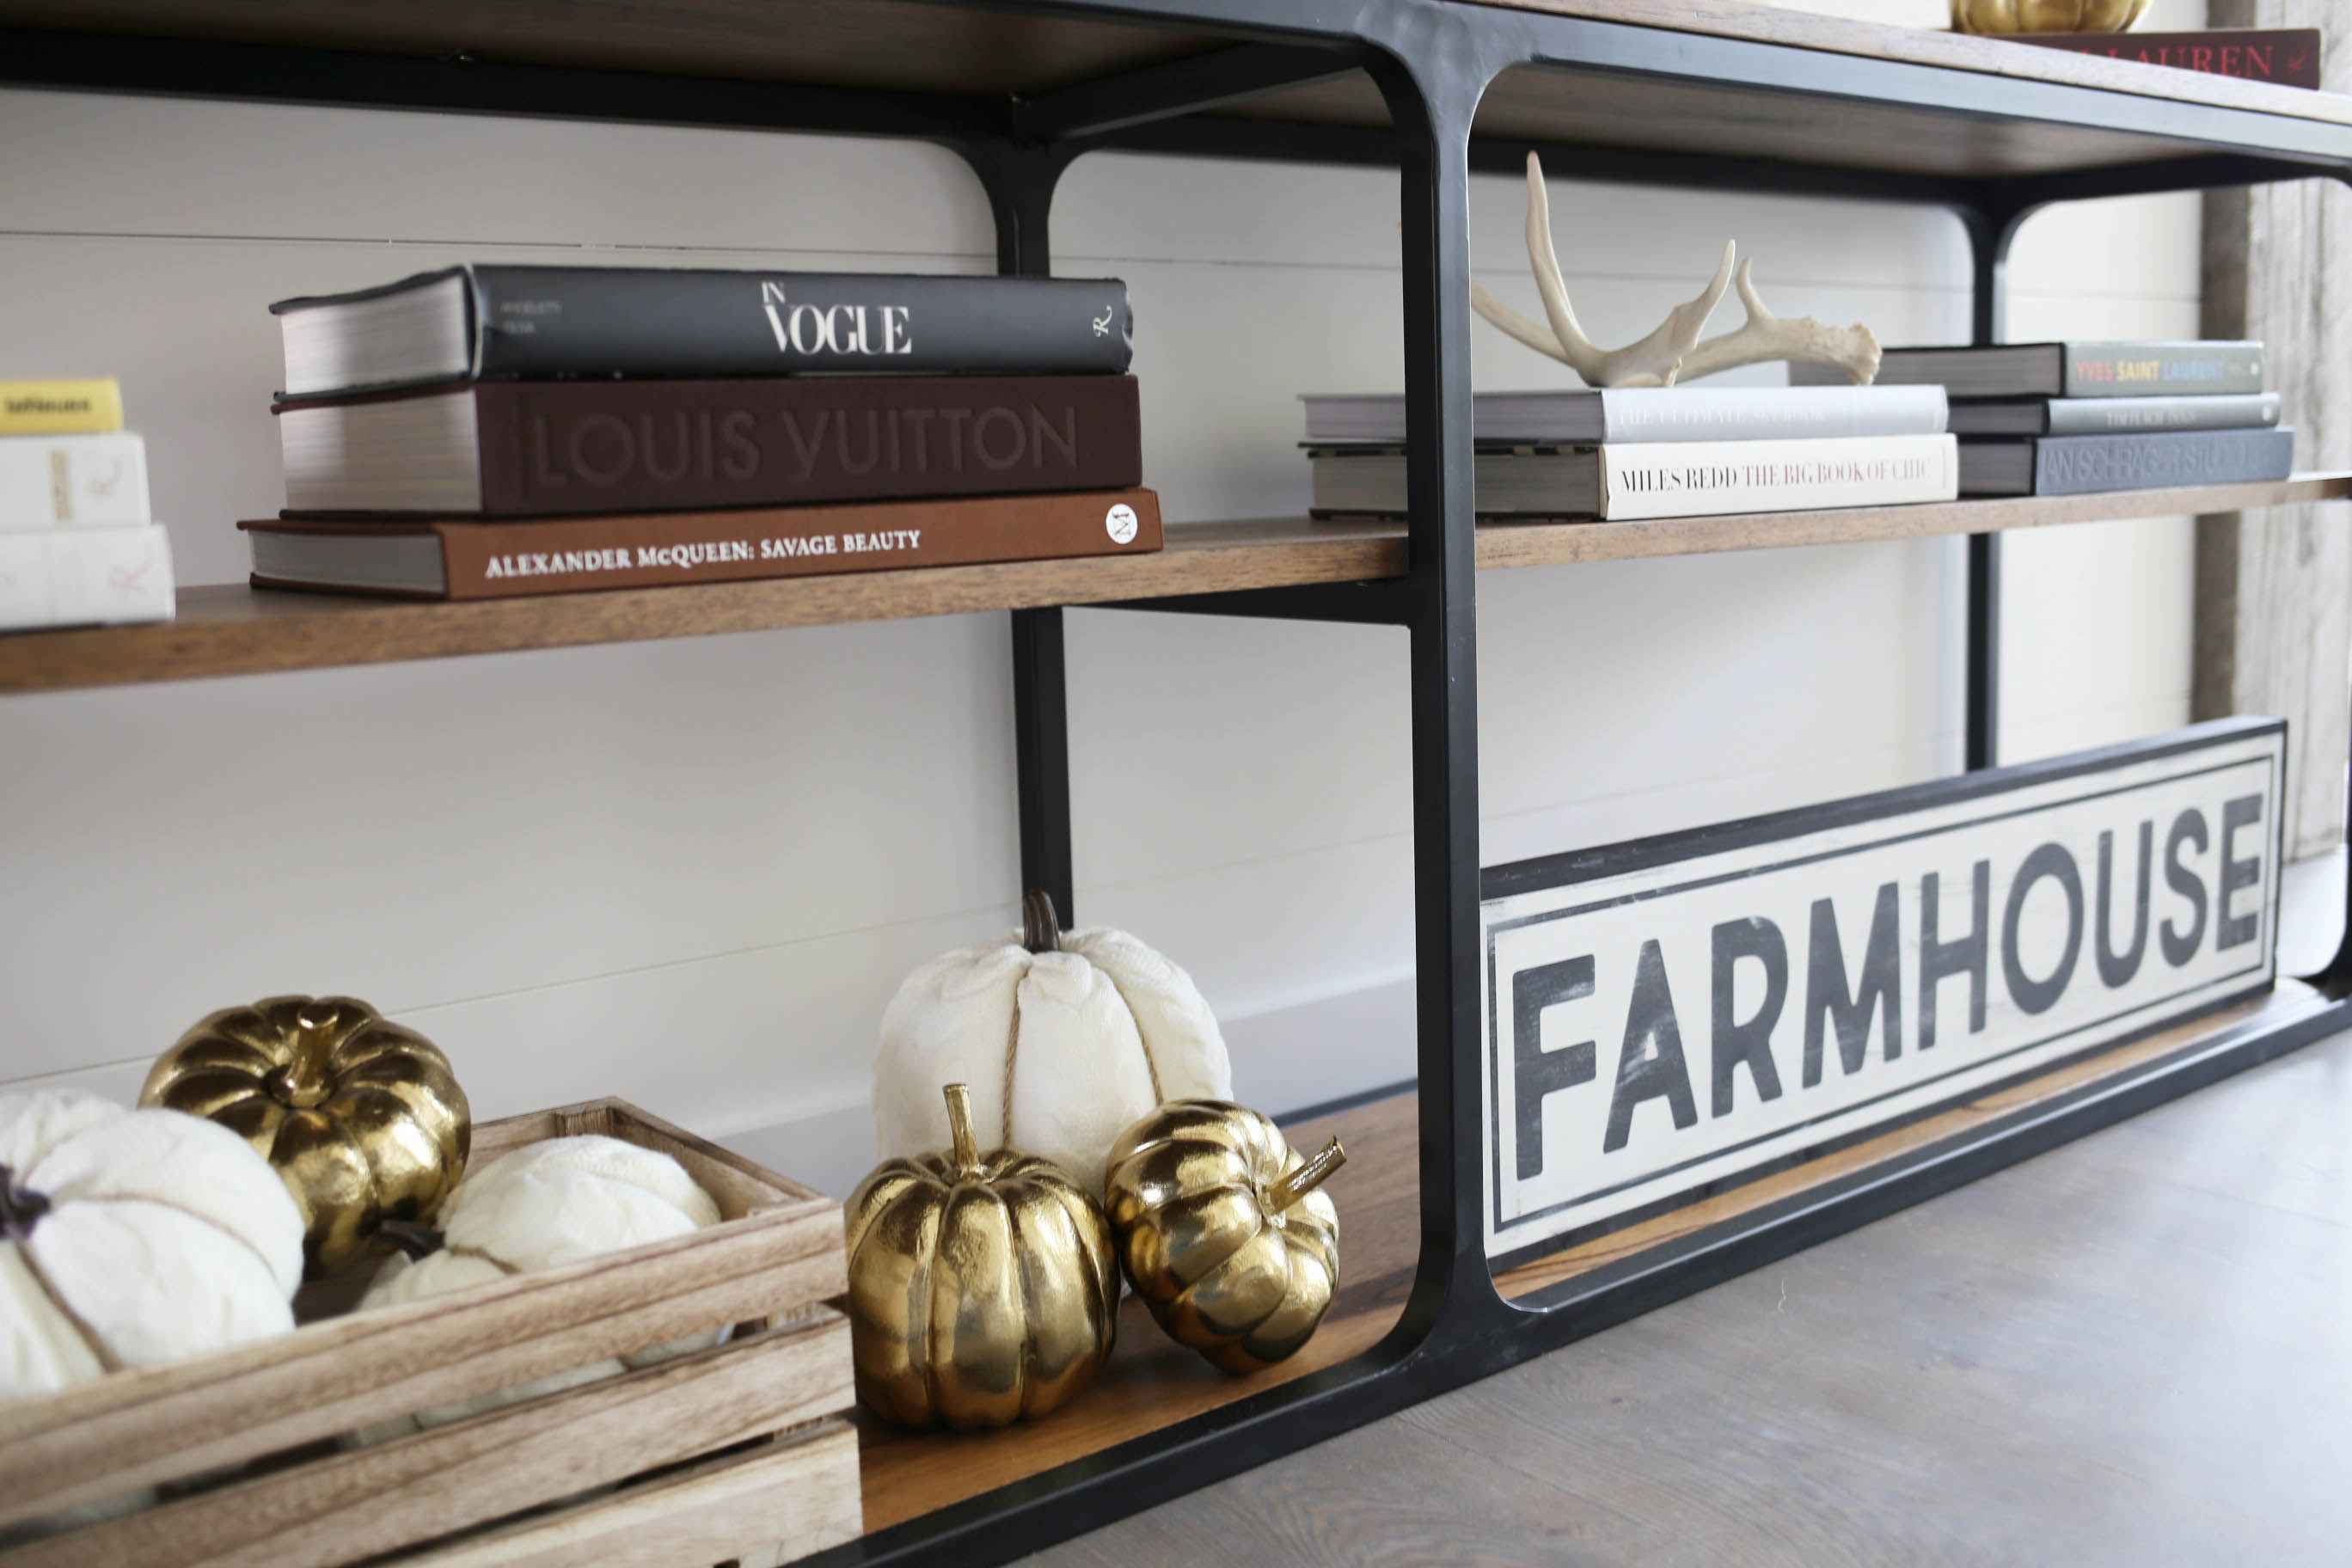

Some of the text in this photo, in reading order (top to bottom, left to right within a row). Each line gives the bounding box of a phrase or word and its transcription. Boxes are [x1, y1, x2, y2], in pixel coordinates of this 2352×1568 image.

[761, 281, 786, 303] IN
[764, 303, 912, 355] VOGUE
[2076, 359, 2113, 382] YVES
[2117, 359, 2160, 382] SAINT
[533, 406, 1078, 487] LOUIS VUITTON
[1621, 468, 1681, 492] MILES
[1687, 467, 1737, 489] REDD
[1742, 463, 1780, 487] THE
[1784, 462, 1813, 486] BIG
[1816, 461, 1865, 484] BOOK
[1866, 459, 1890, 482] OF
[1892, 457, 1932, 481] CHIC
[486, 548, 631, 579] ALEXANDER
[760, 535, 838, 560] SAVAGE
[843, 529, 922, 554] BEAUTY
[1511, 793, 2264, 1181] FARMHOUSE
